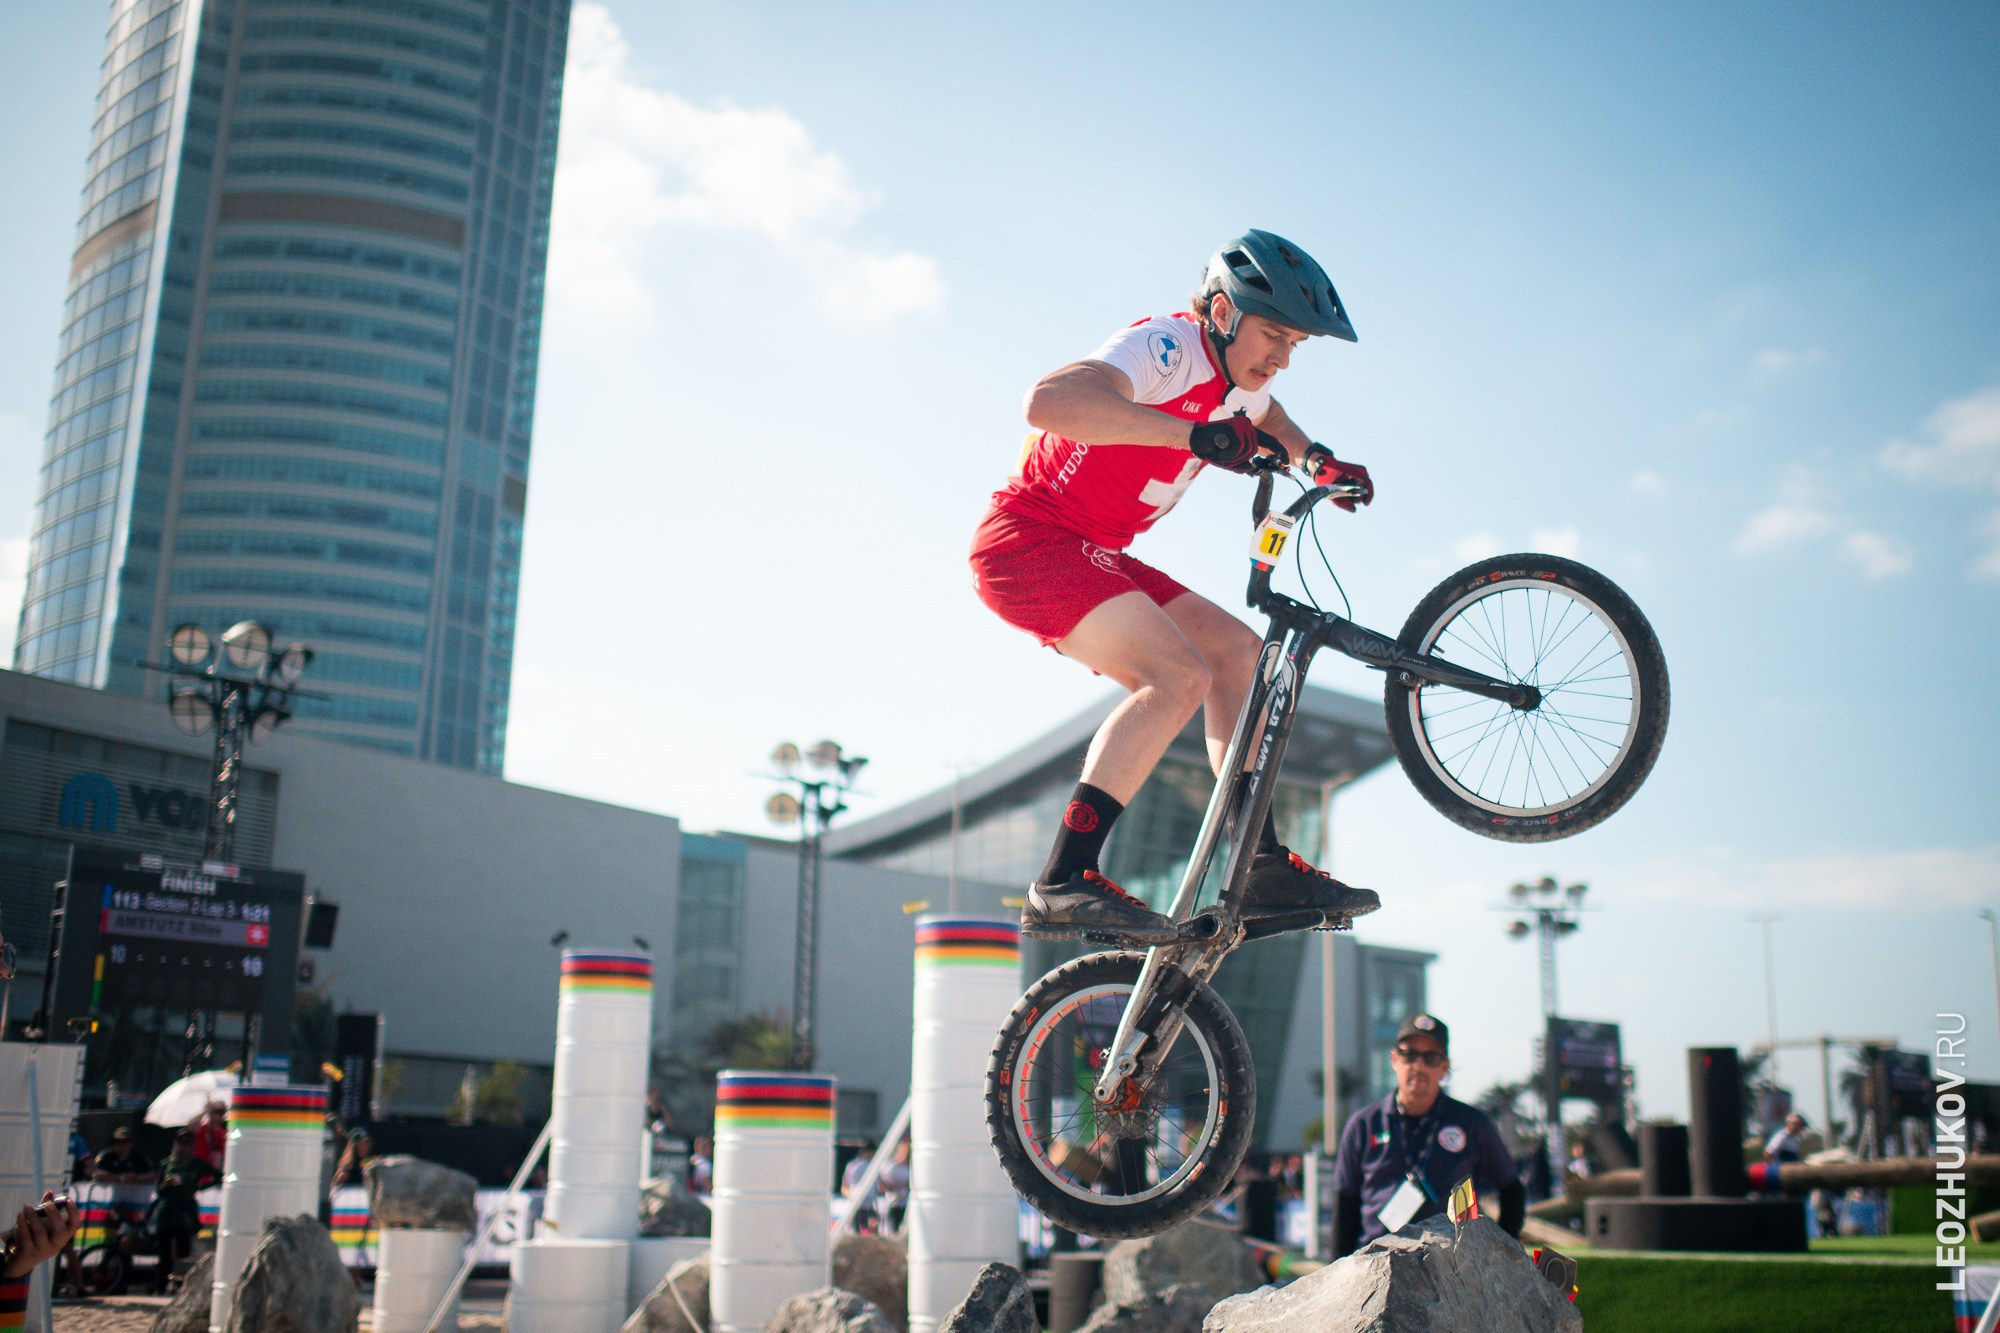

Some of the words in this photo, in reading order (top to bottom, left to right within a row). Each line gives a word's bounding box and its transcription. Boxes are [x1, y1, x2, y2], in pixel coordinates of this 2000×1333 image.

[1058, 442, 1090, 485] TUDO
[1268, 533, 1287, 556] 11
[161, 876, 216, 895] FINISH
